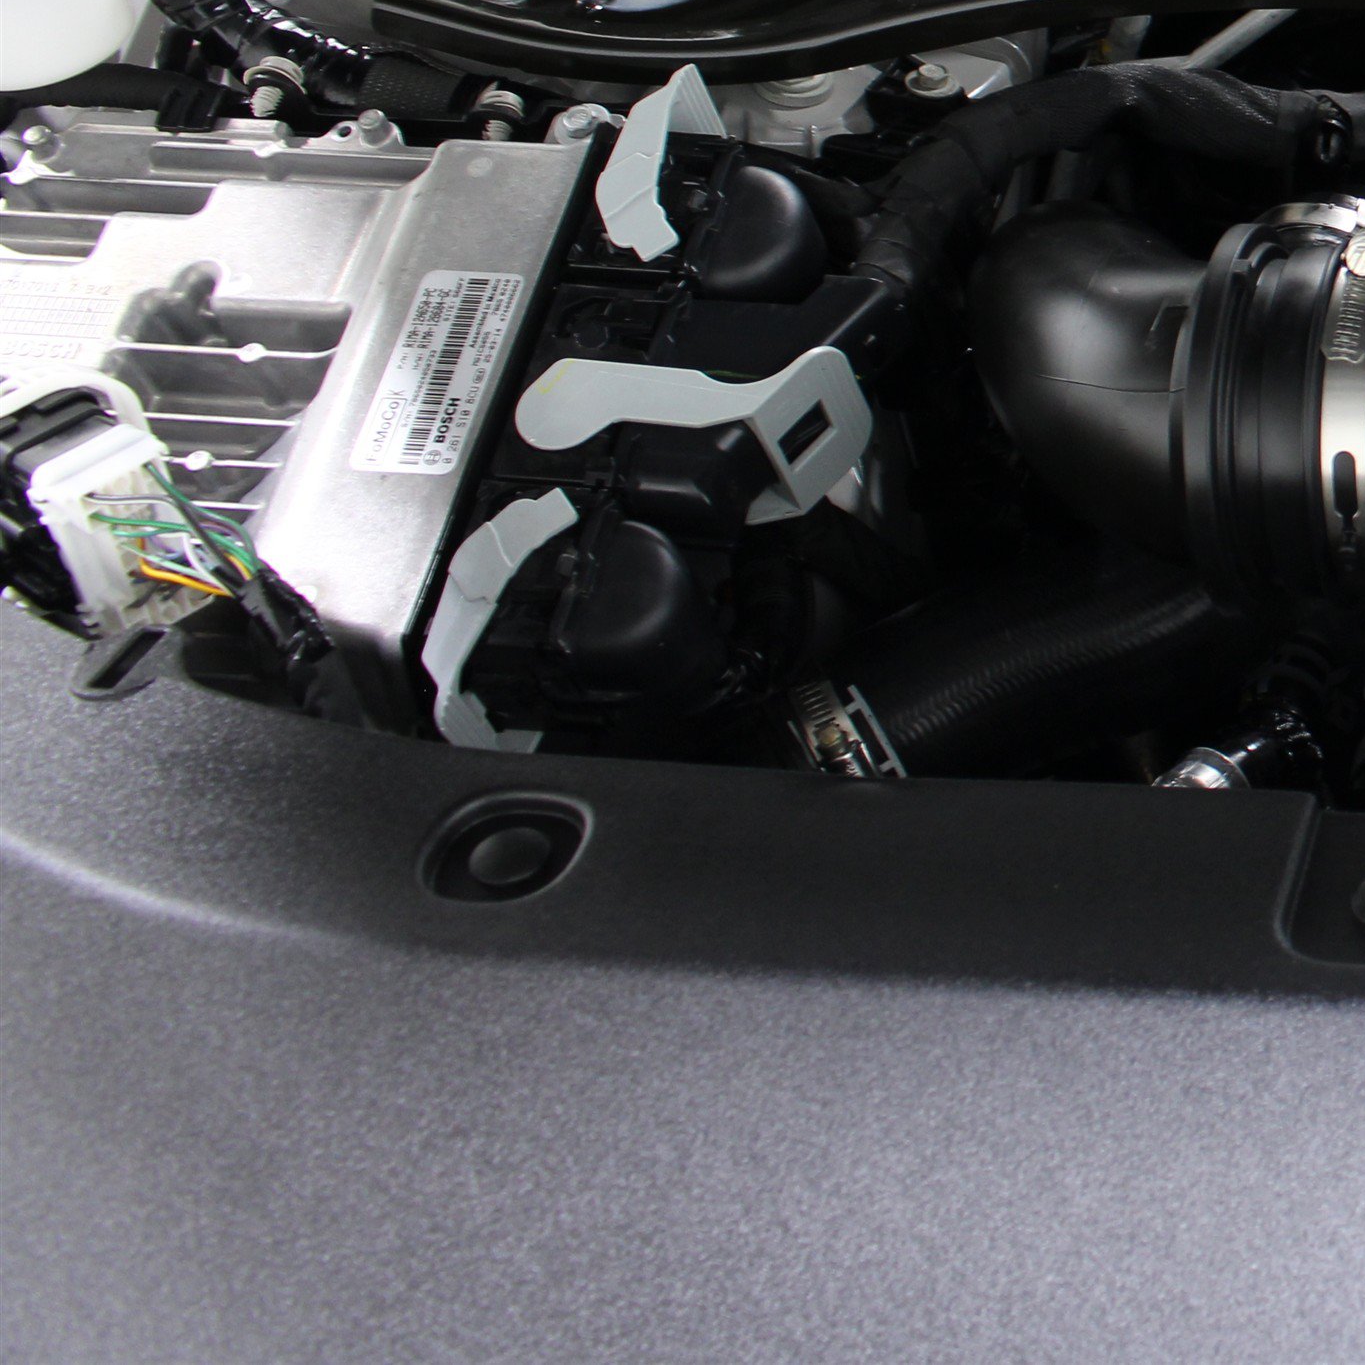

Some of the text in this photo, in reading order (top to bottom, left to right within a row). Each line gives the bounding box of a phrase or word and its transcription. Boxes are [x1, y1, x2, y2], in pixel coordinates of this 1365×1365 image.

[470, 311, 489, 348] Assembled
[488, 279, 501, 301] Mexico
[367, 401, 399, 461] FoMoCo
[433, 398, 460, 443] BOSCH
[449, 435, 462, 452] 261
